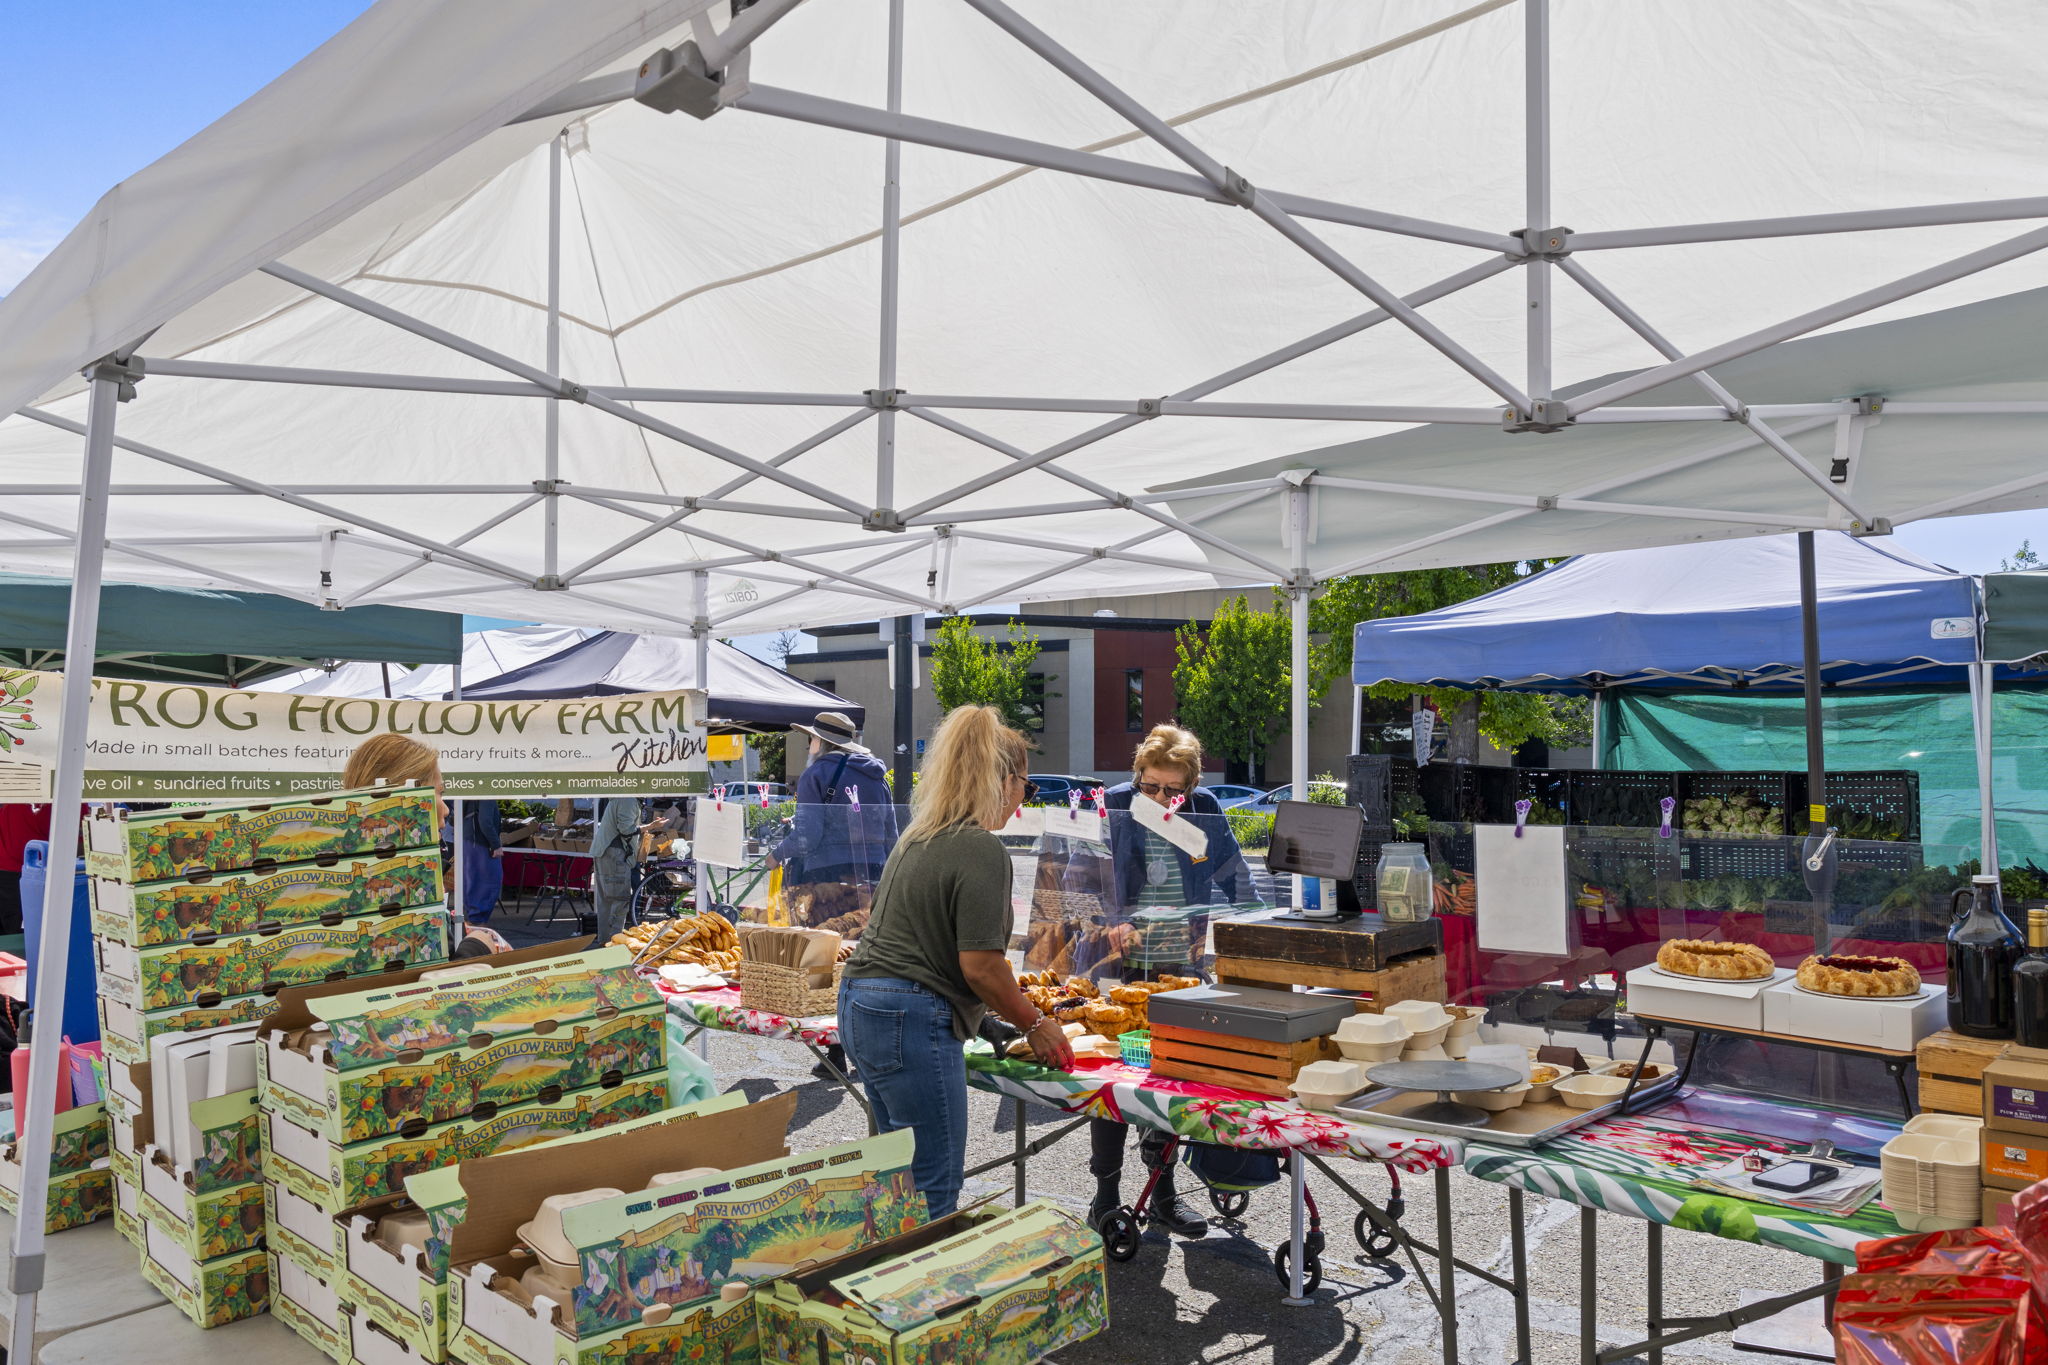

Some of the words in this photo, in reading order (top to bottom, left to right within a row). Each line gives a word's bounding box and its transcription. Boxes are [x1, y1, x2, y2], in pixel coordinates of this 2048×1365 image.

[91, 680, 259, 731] ROG
[288, 694, 544, 736] HOLLOW
[557, 695, 690, 735] FARM
[85, 739, 135, 755] Made
[142, 741, 158, 755] in
[165, 742, 212, 756] small
[218, 742, 288, 758] batches
[488, 746, 527, 760] fruits
[530, 747, 541, 759] &
[545, 748, 592, 759] more...
[611, 728, 708, 774] Kitchen
[81, 775, 106, 790] ive
[111, 775, 131, 790] oil
[153, 775, 227, 791] sundried
[230, 775, 271, 791] fruits
[443, 776, 475, 790] akes
[490, 778, 553, 789] conserves
[567, 775, 638, 789] marmalades
[650, 775, 691, 790] granola
[231, 816, 264, 835] FROG
[265, 810, 316, 826] HOLLOW
[317, 811, 347, 822] FARM
[239, 880, 271, 898] FROG
[272, 871, 322, 888] HOLLOW
[324, 872, 353, 883] FARM
[244, 941, 276, 960] FROG
[277, 932, 328, 948] HOLLOW
[329, 931, 358, 943] FARM
[249, 1001, 280, 1020] FROG
[451, 1057, 485, 1077] FROG
[488, 1043, 541, 1062] HOLLOW
[542, 1039, 574, 1052] FARM
[454, 1129, 489, 1150] FROG
[490, 1113, 544, 1133] HOLLOW
[545, 1108, 577, 1122] FARM
[787, 1159, 825, 1176] APRICOTS
[829, 1150, 863, 1166] PEACHES
[735, 1170, 784, 1189] NECTARINES
[779, 1178, 809, 1198] FROG
[696, 1204, 728, 1217] FARM
[731, 1193, 781, 1216] HOLLOW
[703, 1309, 741, 1338] FROG
